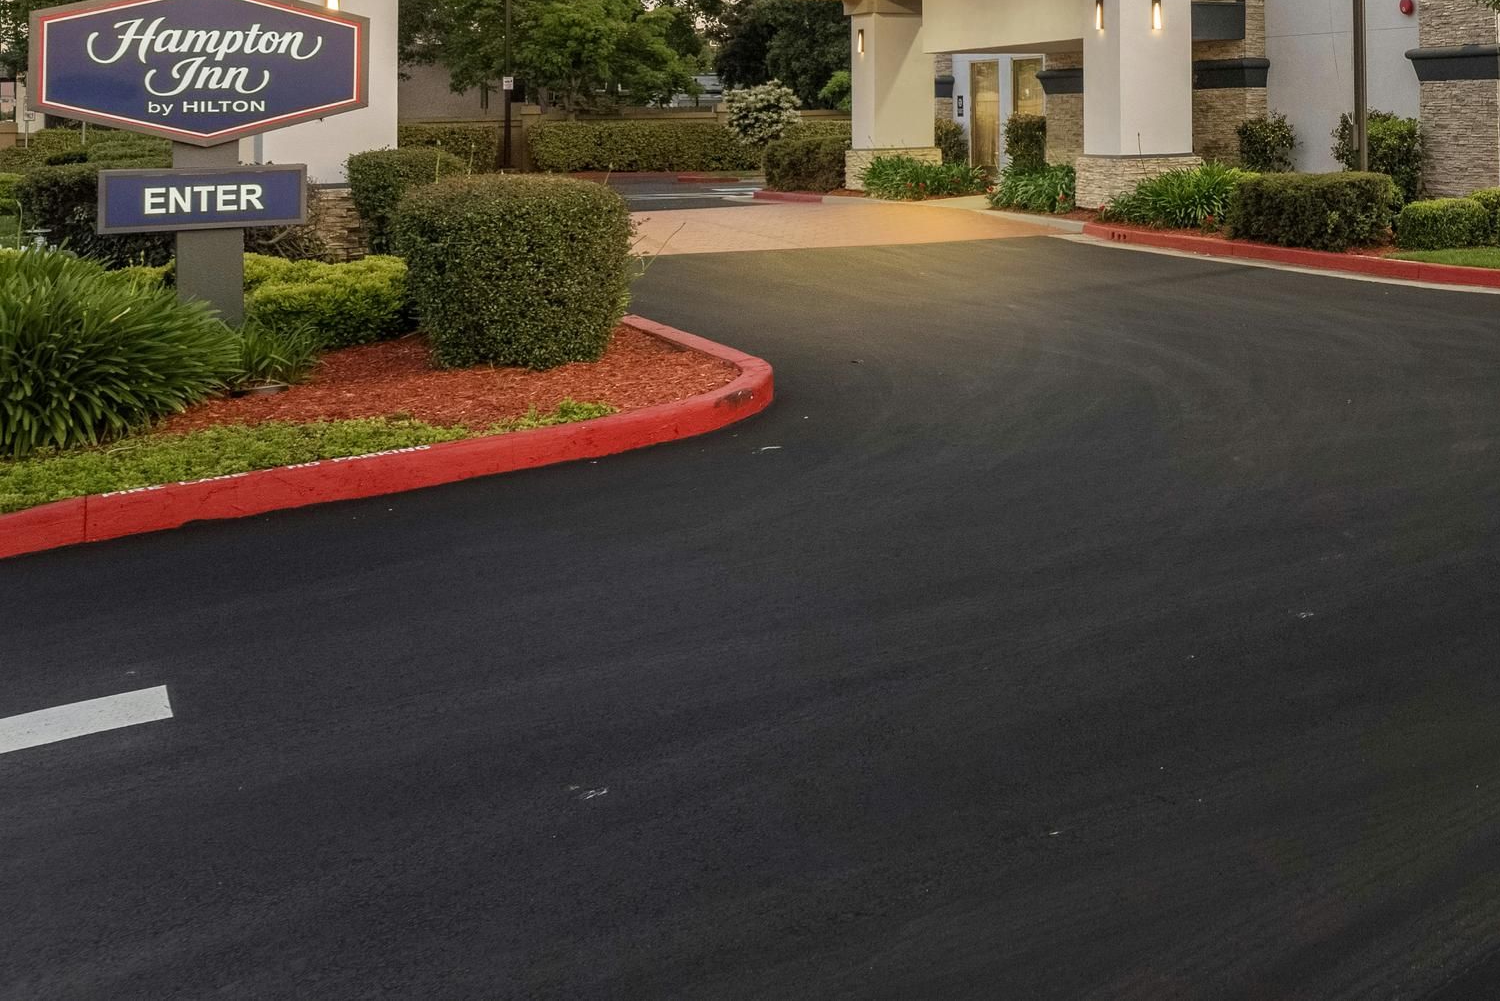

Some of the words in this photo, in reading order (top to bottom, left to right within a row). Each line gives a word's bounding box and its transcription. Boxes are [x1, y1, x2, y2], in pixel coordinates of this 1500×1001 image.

[86, 16, 323, 64] Hampton
[144, 56, 270, 97] Inn
[148, 101, 173, 116] by
[182, 100, 265, 113] HILTON
[144, 183, 264, 215] ENTER
[331, 444, 431, 463] PARKING
